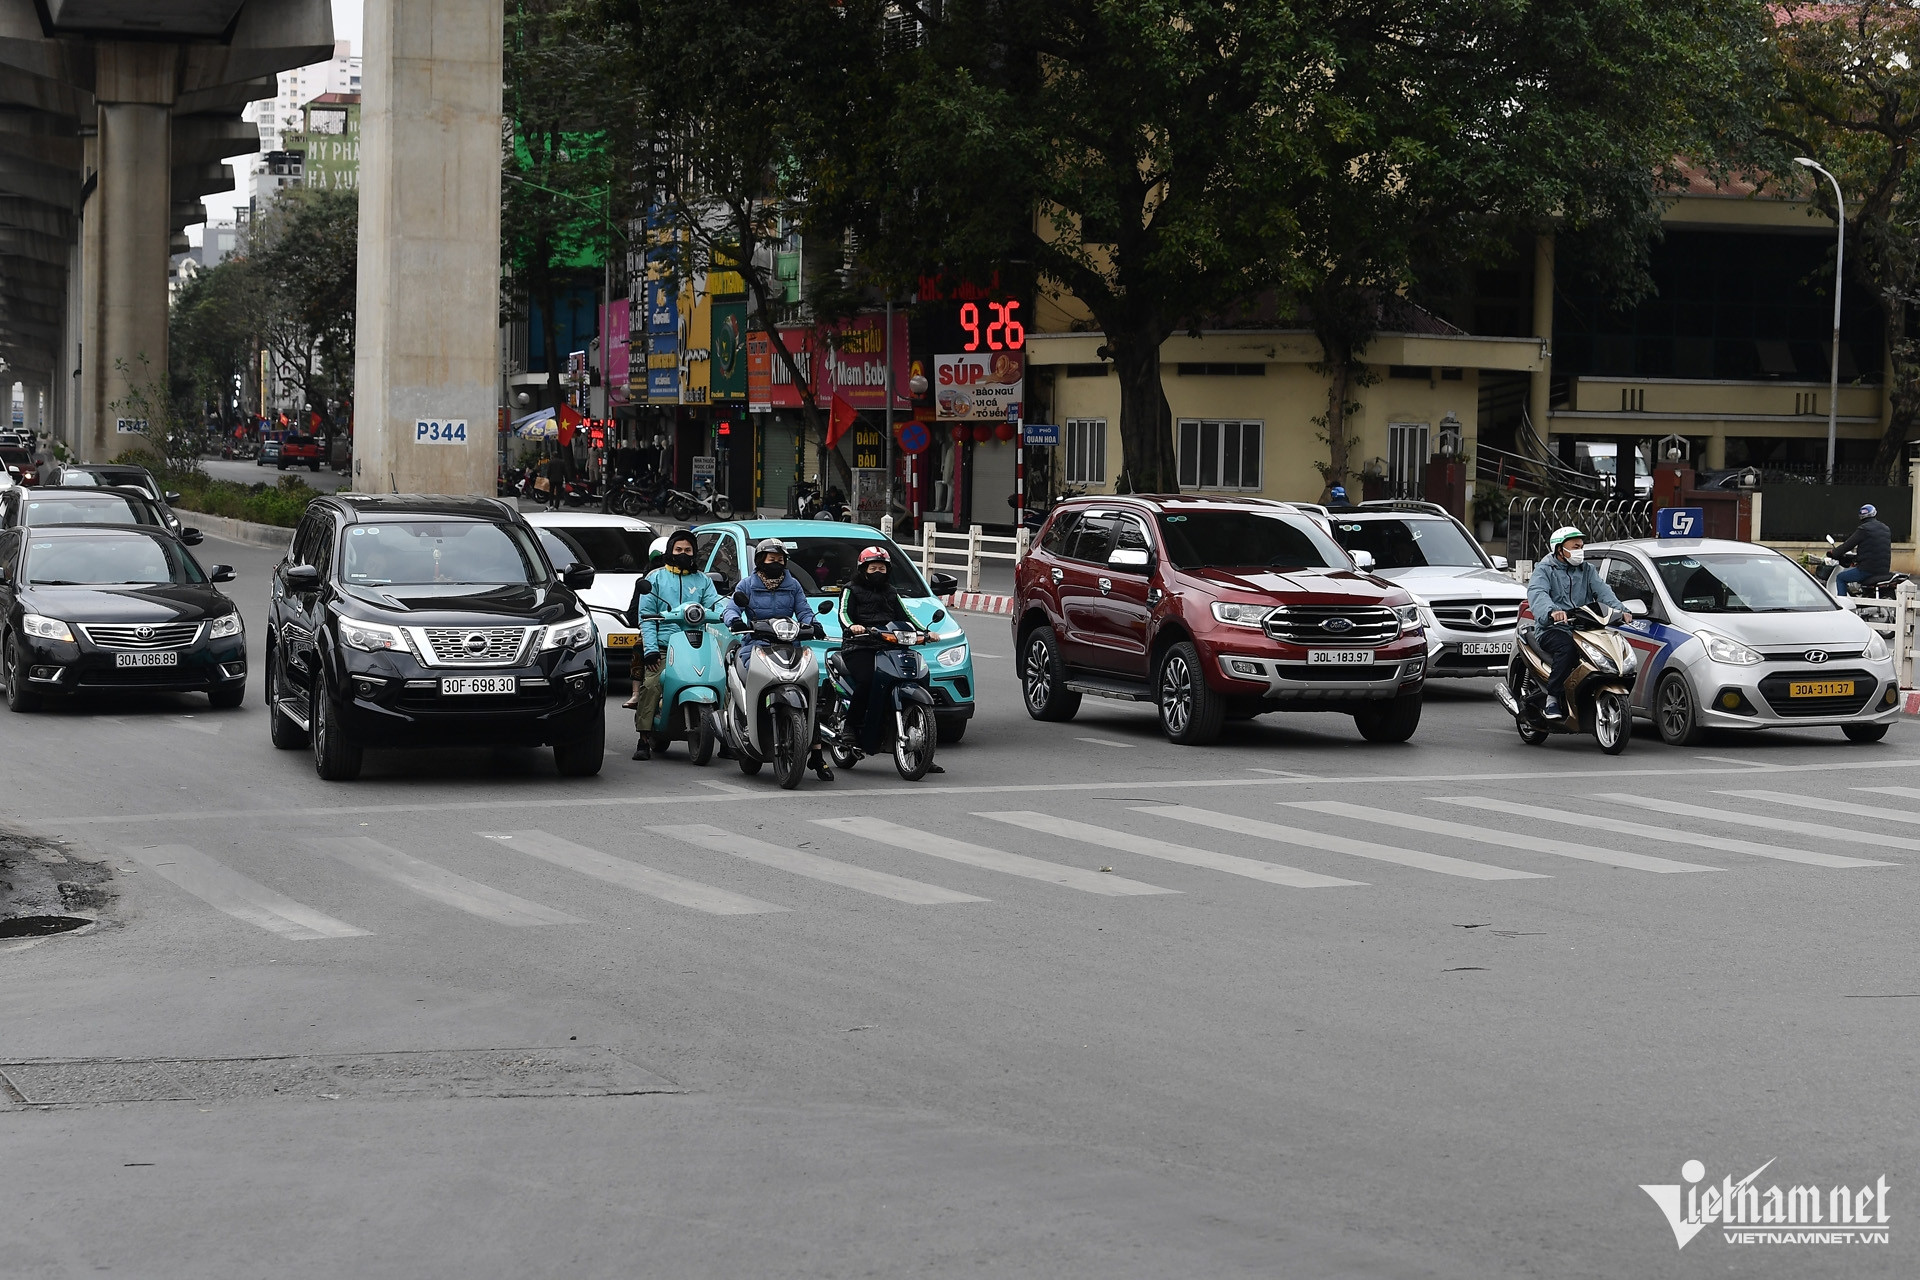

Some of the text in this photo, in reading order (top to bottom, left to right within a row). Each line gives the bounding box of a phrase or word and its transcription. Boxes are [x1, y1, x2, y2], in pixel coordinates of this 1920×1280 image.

[308, 136, 327, 160] MỸ
[308, 163, 327, 189] HÀ
[938, 357, 984, 386] SÚP
[417, 422, 466, 441] P344
[1026, 435, 1057, 444] QUAN HOA
[1673, 511, 1694, 535] G7
[1463, 642, 1513, 655] 30E-435.09
[118, 653, 176, 666] 30A-086.89
[1313, 652, 1369, 663] 30L-183.97
[443, 678, 514, 693] 30F-698.30
[1795, 683, 1849, 695] 30A-311.37
